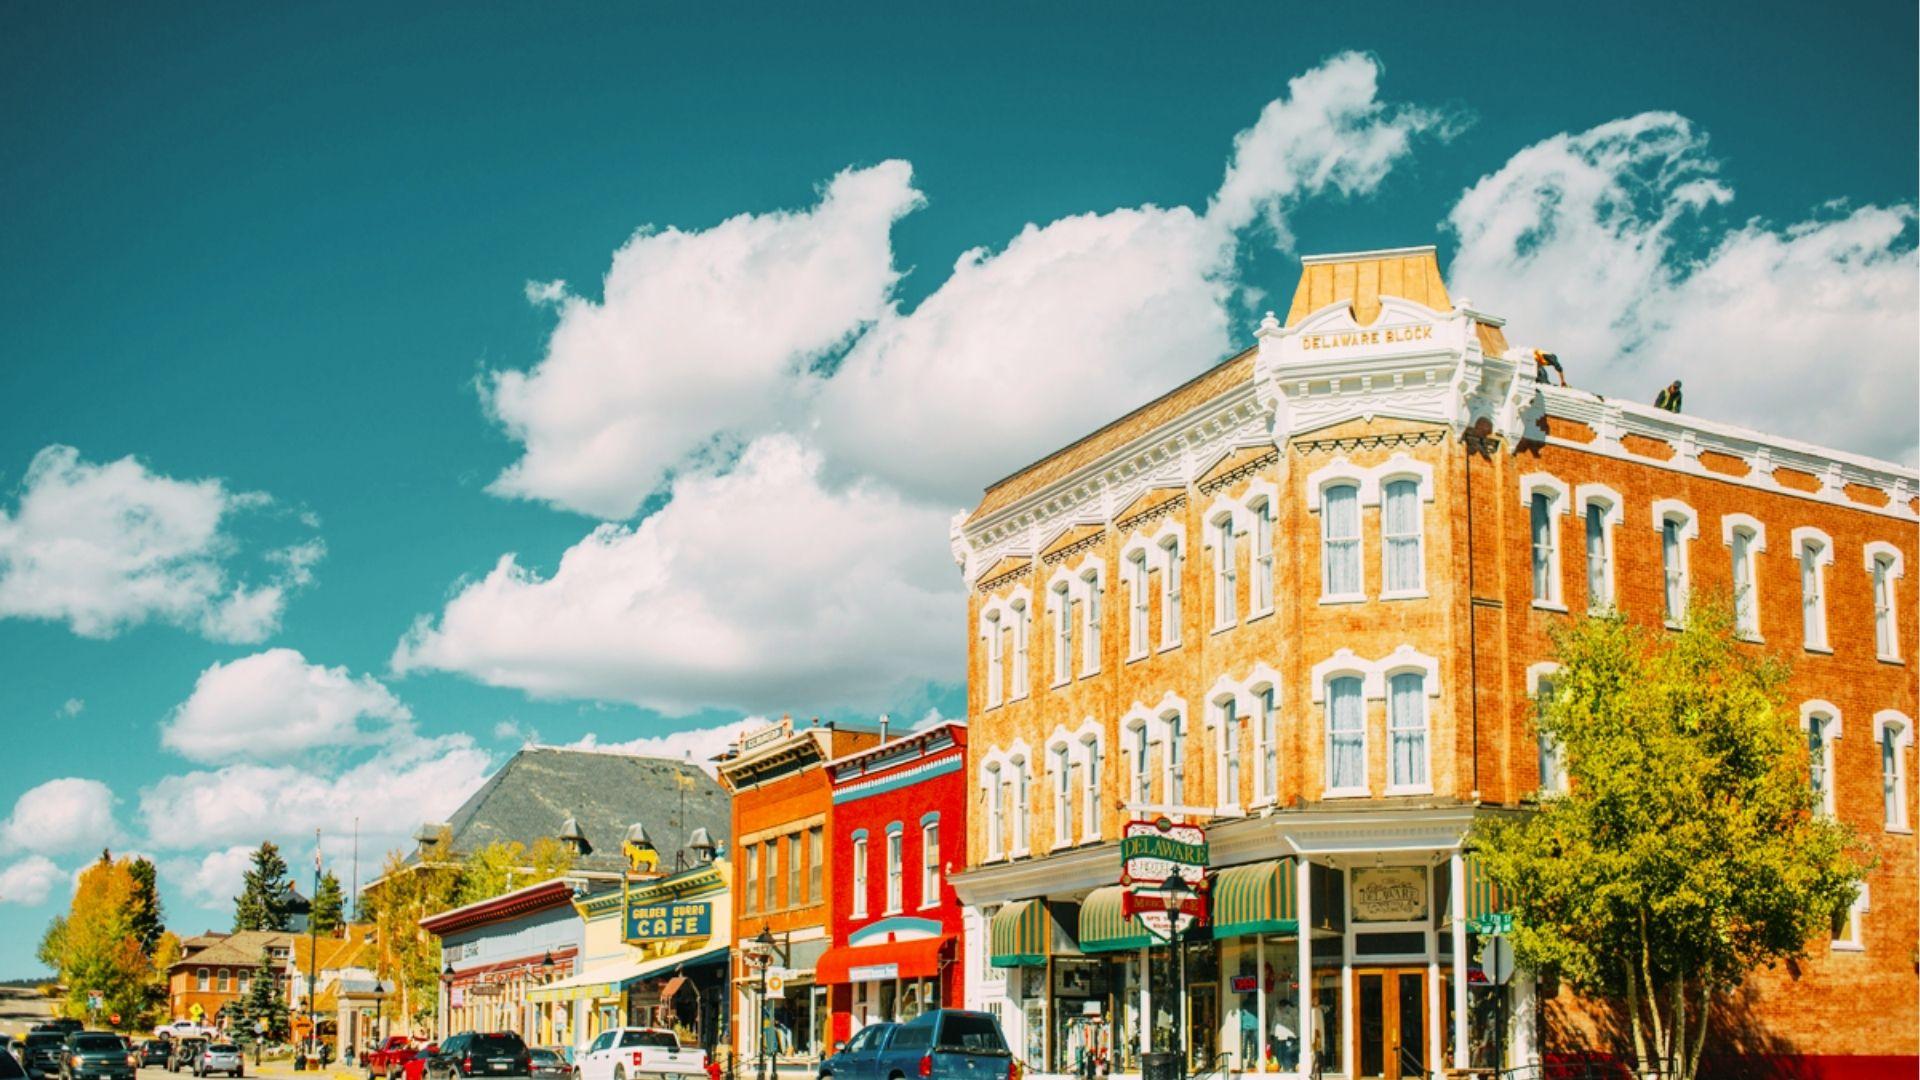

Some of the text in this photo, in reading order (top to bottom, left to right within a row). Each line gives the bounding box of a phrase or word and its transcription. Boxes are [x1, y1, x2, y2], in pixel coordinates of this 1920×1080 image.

[1302, 326, 1433, 350] DELAWARE BLOCK
[1125, 838, 1206, 861] DELAWARE
[632, 904, 705, 919] GOLDEN BURRO
[637, 917, 698, 936] CAFE
